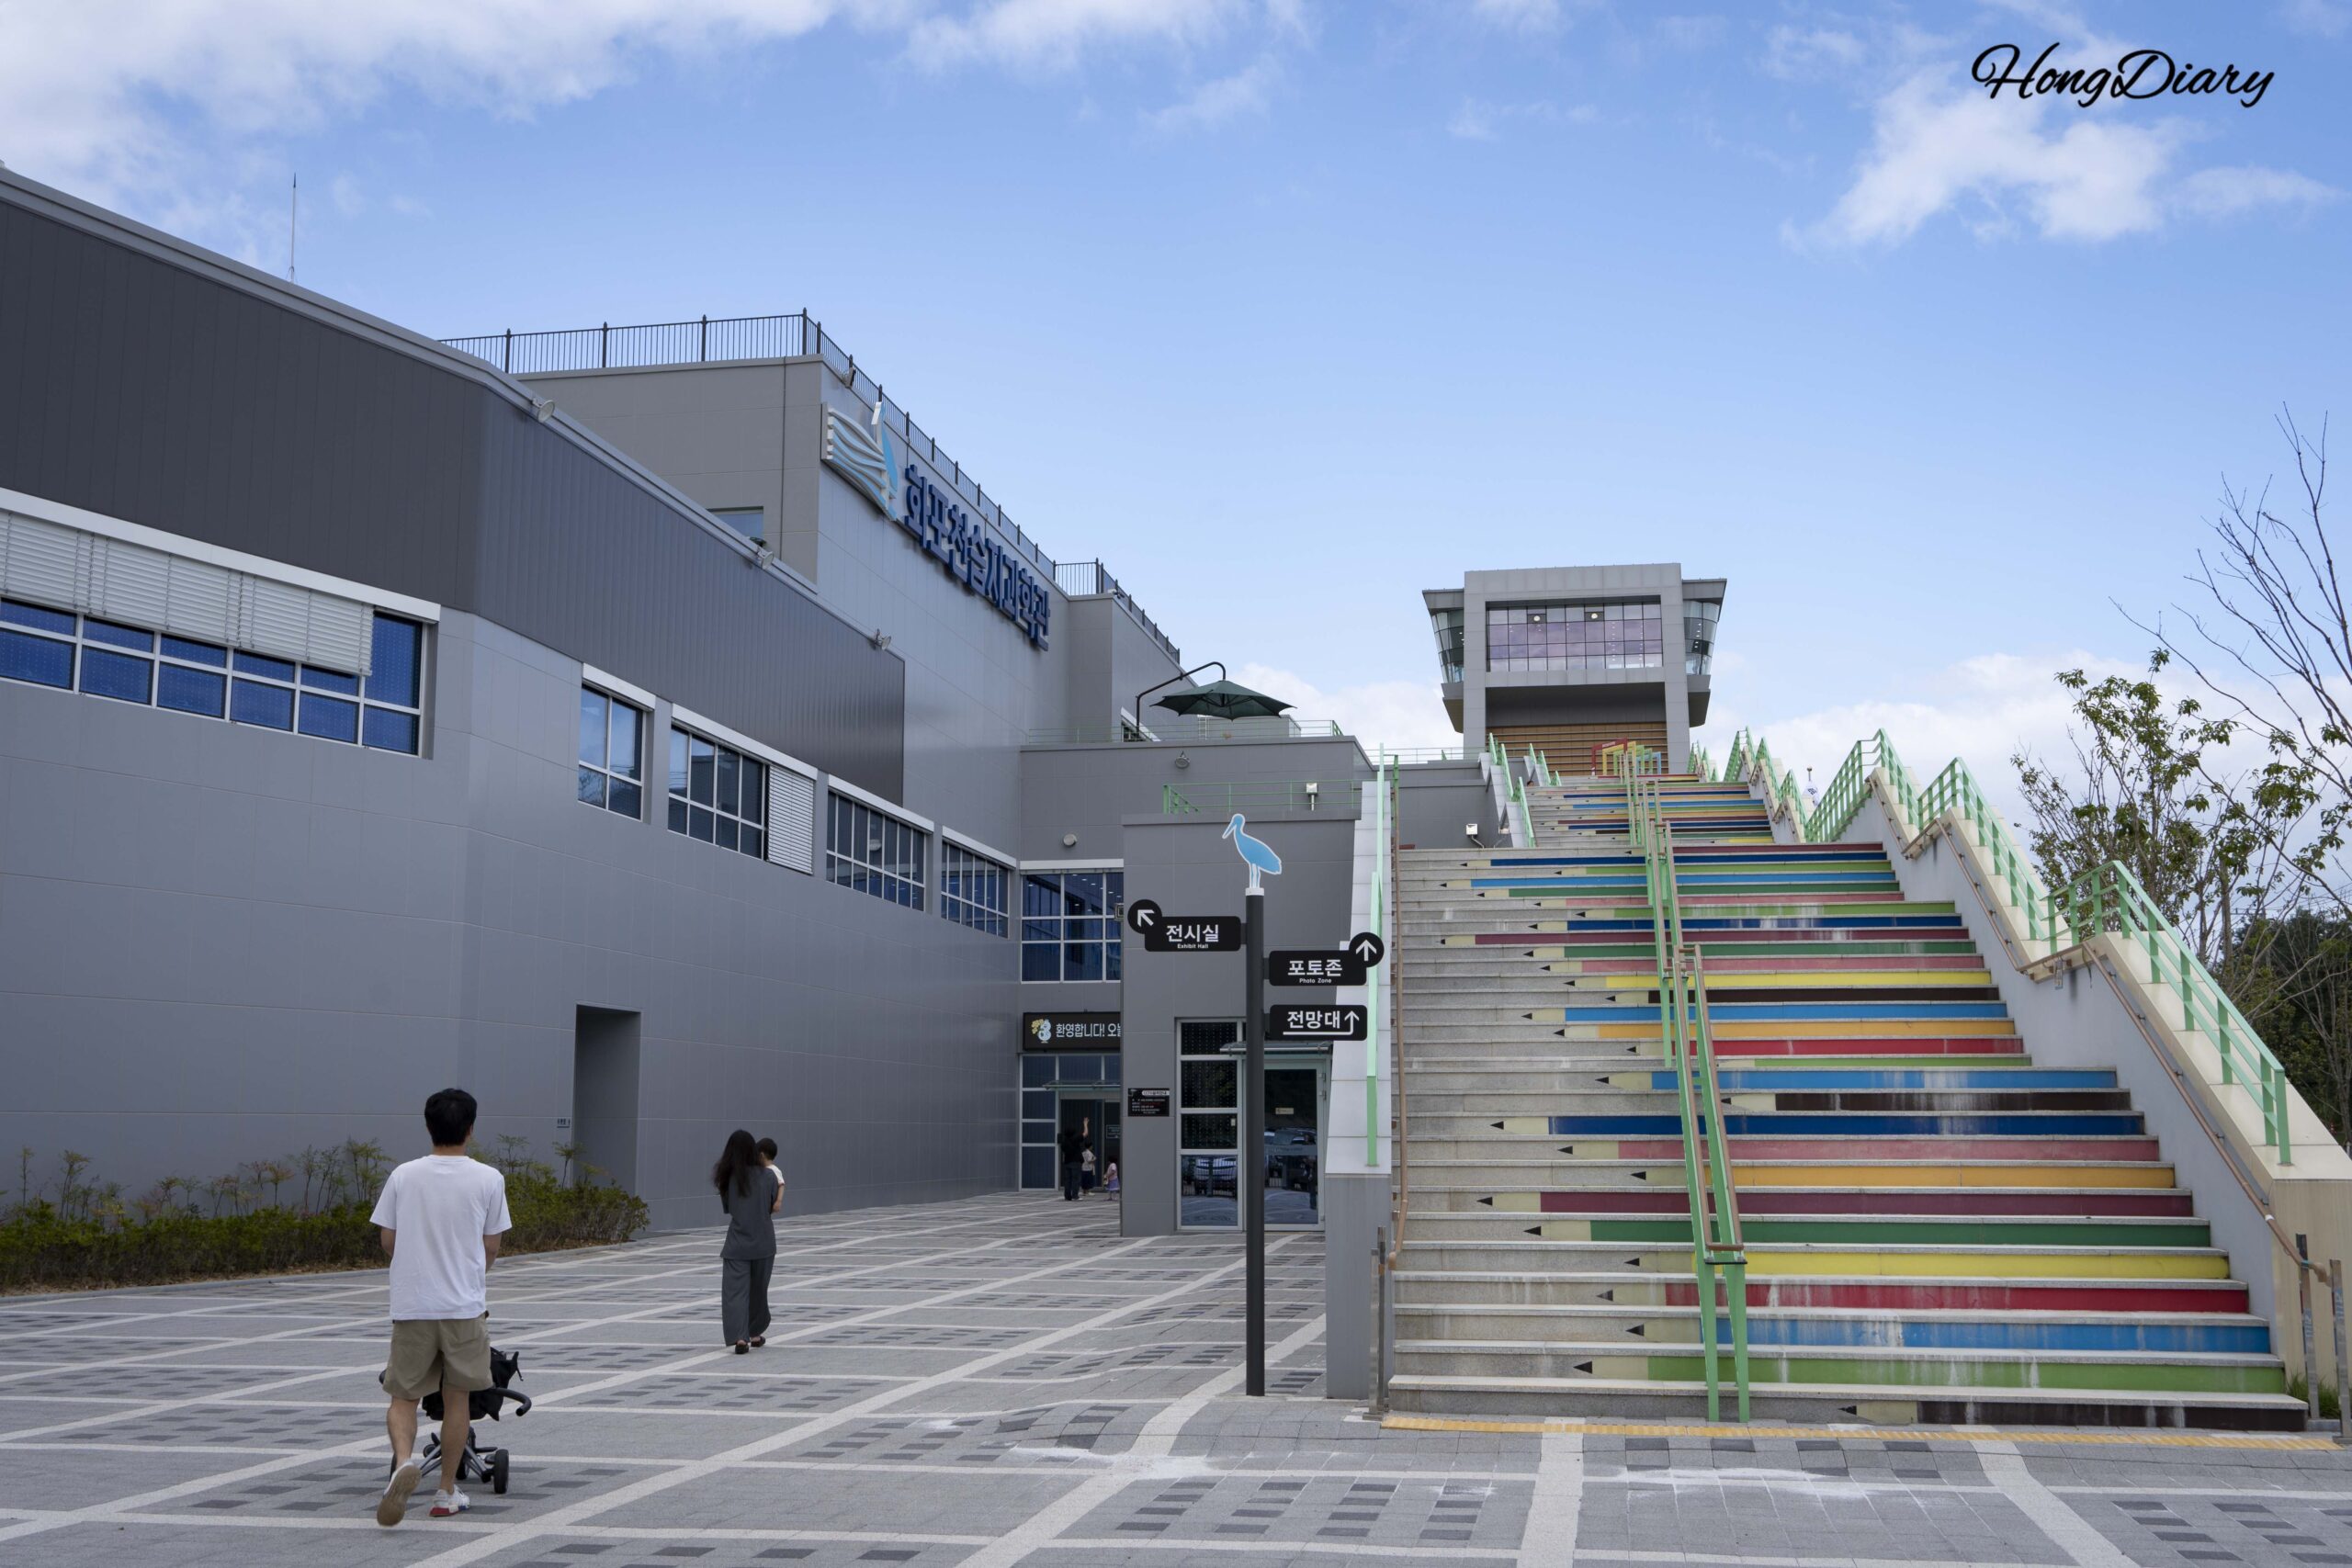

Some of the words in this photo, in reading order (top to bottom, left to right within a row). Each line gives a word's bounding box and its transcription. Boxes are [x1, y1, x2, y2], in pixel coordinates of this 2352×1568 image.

[904, 464, 1050, 651] 화포천습지과학관
[1166, 924, 1219, 942] 전시실
[1287, 959, 1342, 976] 포토존
[1287, 1010, 1340, 1029] 전망대
[1056, 1023, 1105, 1038] 환영합니다!
